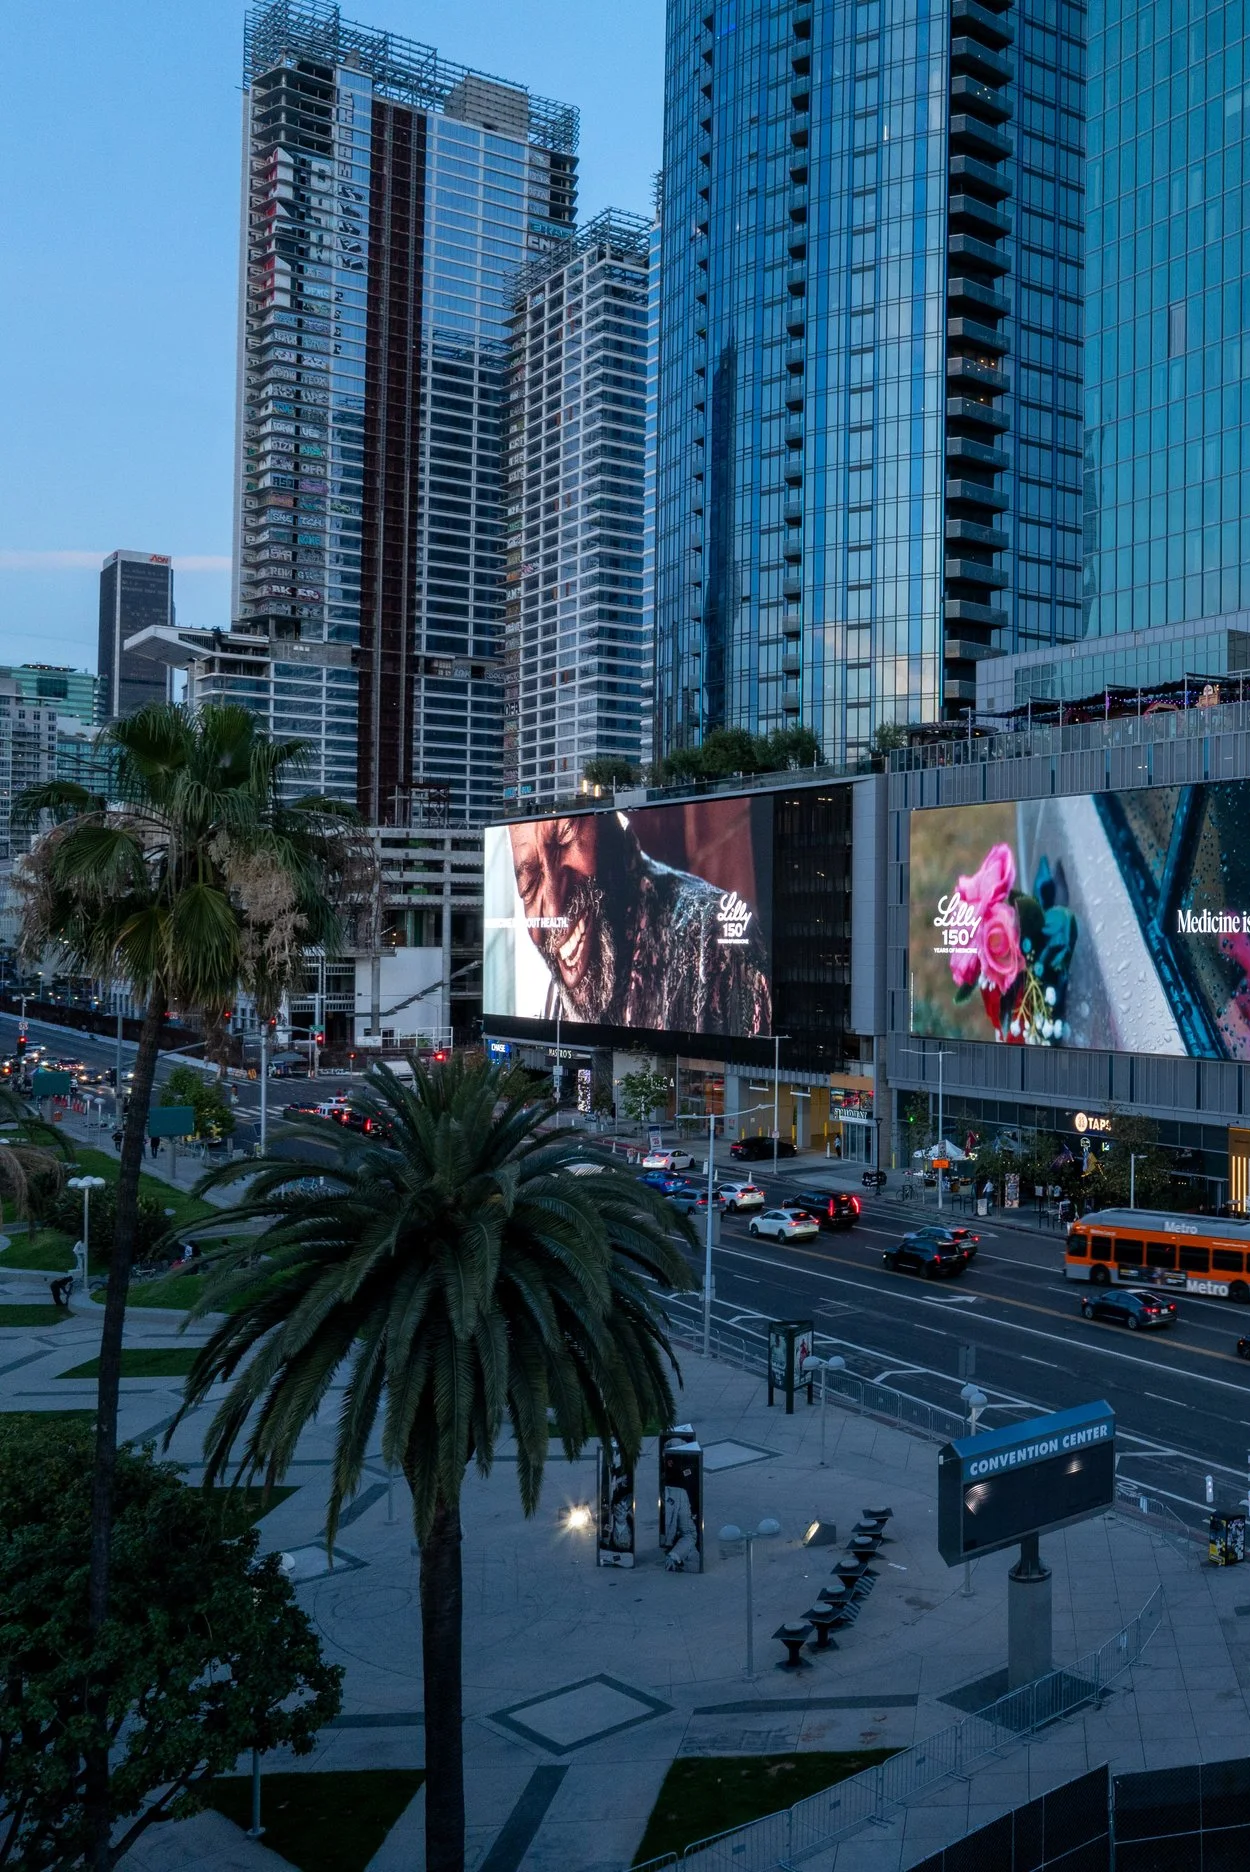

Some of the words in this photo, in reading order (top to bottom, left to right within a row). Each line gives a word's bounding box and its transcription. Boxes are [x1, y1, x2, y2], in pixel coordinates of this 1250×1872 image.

[717, 891, 752, 931] Lilly
[934, 892, 982, 938] Lilly
[723, 922, 743, 937] 150
[1177, 909, 1240, 933] Medicine
[942, 929, 969, 946] 150
[491, 1043, 506, 1053] CHASE
[548, 1048, 572, 1059] MASRO'S
[1164, 1221, 1198, 1235] Metro
[1186, 1279, 1229, 1297] Metro
[970, 1438, 1058, 1476] CONVENTION
[1062, 1424, 1108, 1448] CENTER
